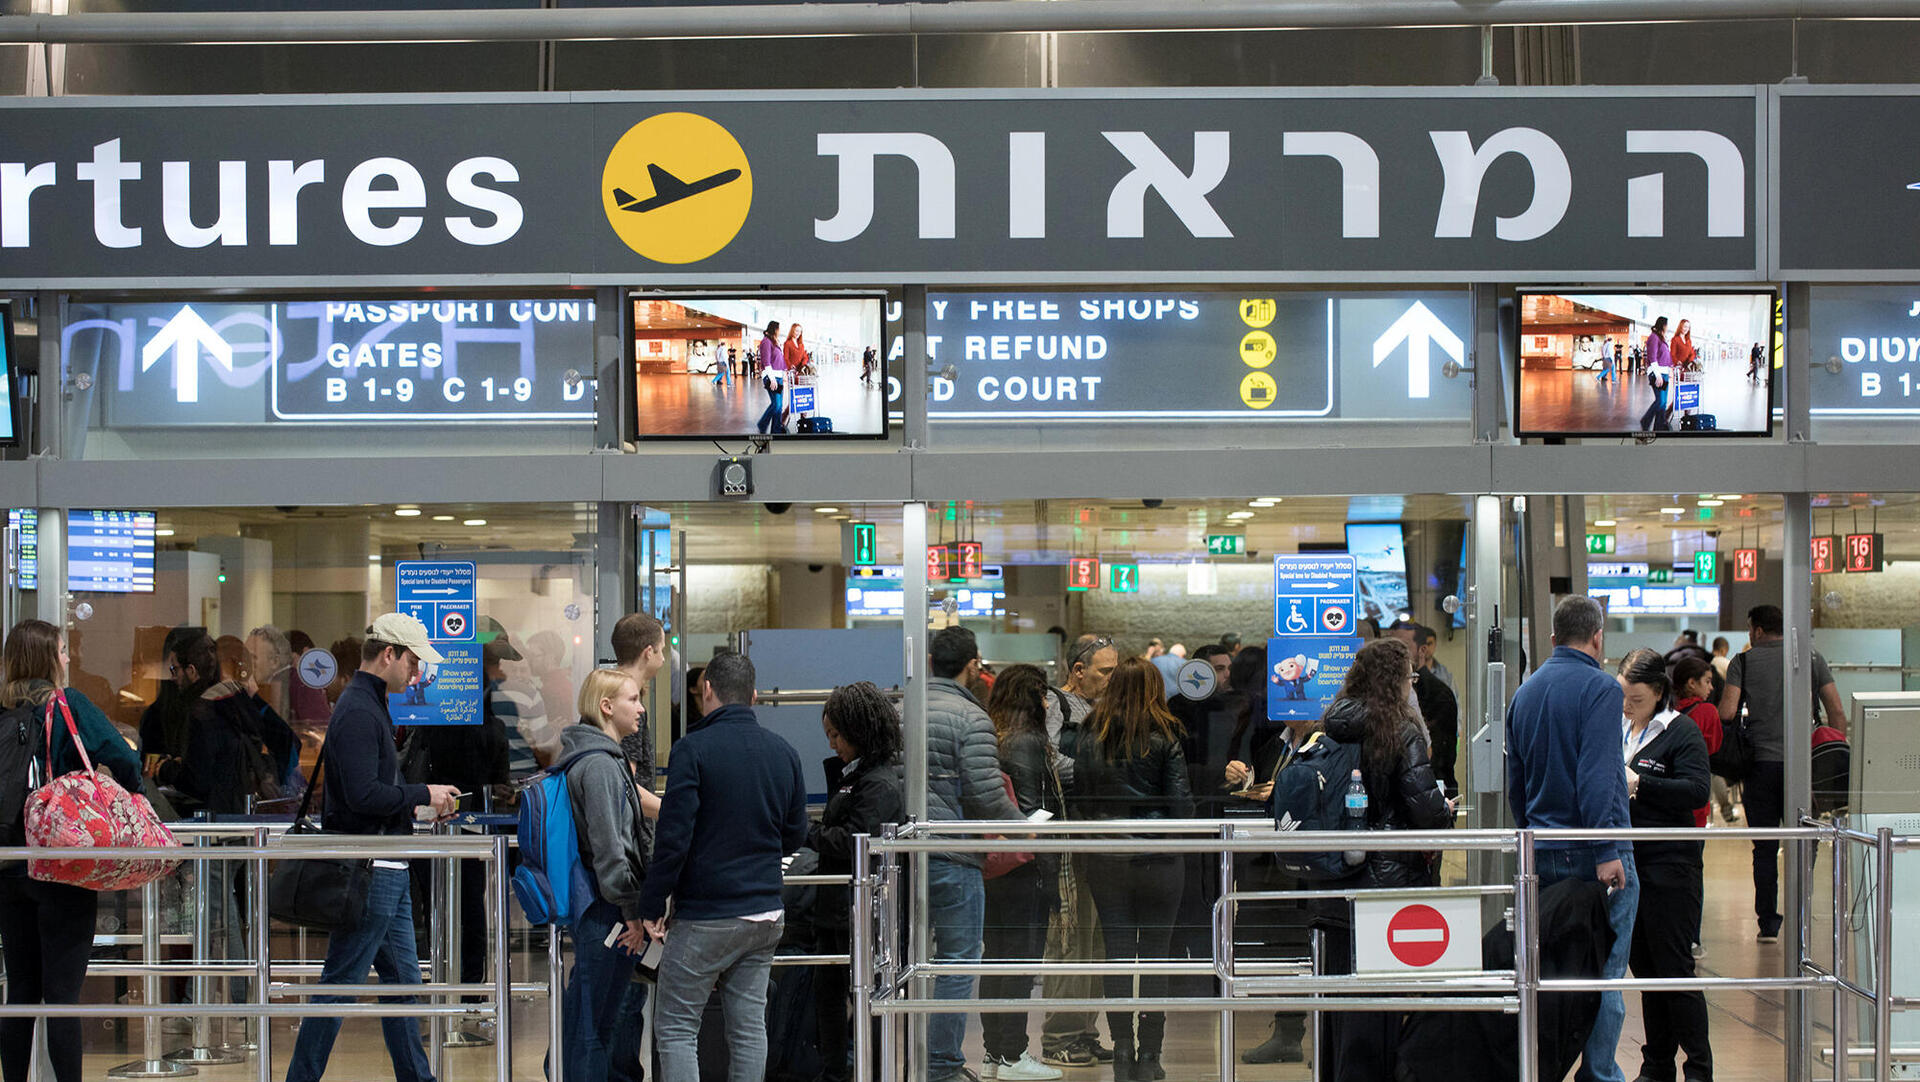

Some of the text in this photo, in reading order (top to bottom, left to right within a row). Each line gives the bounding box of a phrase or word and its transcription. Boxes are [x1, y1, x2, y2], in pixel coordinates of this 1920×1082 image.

[0, 137, 525, 248] rtures
[814, 126, 1746, 243] המראות
[326, 302, 494, 323] PASSPORT
[970, 300, 1060, 321] FREE
[1080, 299, 1200, 321] SHOPS
[326, 342, 443, 368] GATES
[965, 335, 1108, 361] REFUND
[326, 377, 347, 402] B
[363, 377, 414, 402] 1-9
[442, 377, 465, 402] C
[481, 377, 532, 402] 1-9
[977, 376, 1102, 401] COURT
[1861, 372, 1882, 397] B
[861, 528, 869, 548] 1
[1851, 537, 1869, 557] 16
[928, 549, 940, 566] 3
[965, 546, 975, 564] 2
[1811, 540, 1829, 559] 15
[1078, 560, 1090, 575] 5
[1699, 554, 1712, 571] 13
[1738, 552, 1753, 568] 14
[448, 578, 471, 586] Passengers
[1119, 566, 1130, 581] 7
[460, 670, 475, 678] your
[437, 683, 463, 691] boarding
